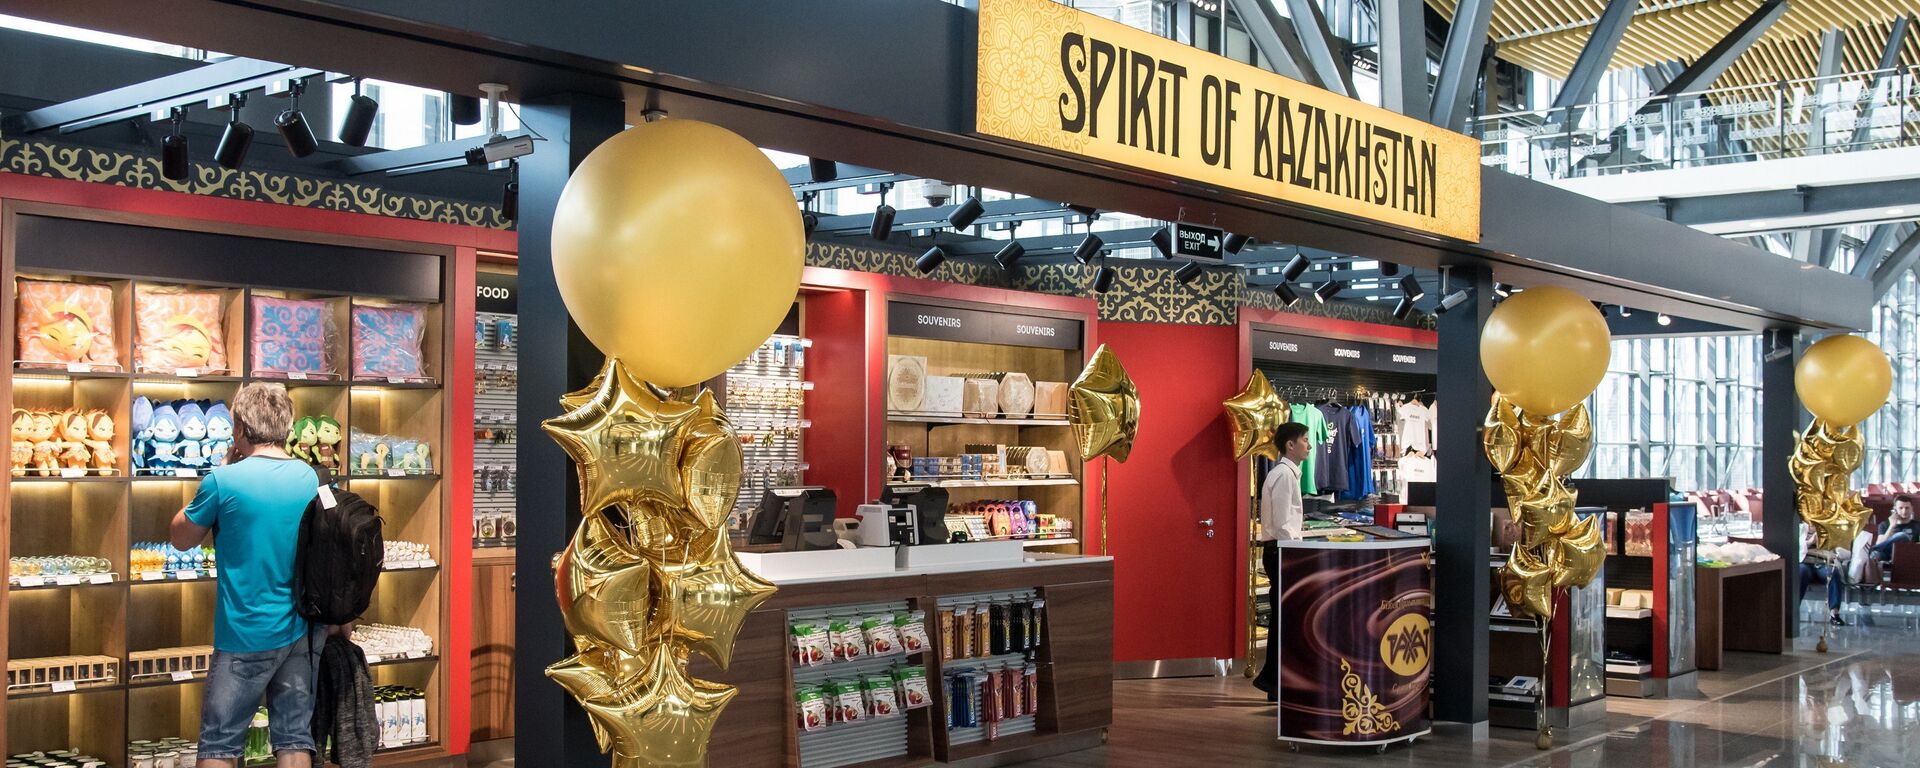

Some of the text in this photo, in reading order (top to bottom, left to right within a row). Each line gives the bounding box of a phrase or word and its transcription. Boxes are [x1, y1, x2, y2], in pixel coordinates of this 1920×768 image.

[1058, 31, 1437, 218] SPIRIT OF KAZAKHSTAN
[1179, 230, 1206, 244] ВЫХОД
[1184, 241, 1201, 251] EXIT
[476, 285, 509, 299] FOOD
[917, 314, 961, 328] SOUVENIRS
[1016, 324, 1055, 337] SOUVENIRS
[1269, 341, 1299, 353] SOUVENIRS
[1334, 347, 1361, 359] SOUVENIRS
[1392, 353, 1417, 365] SOUVENIRS
